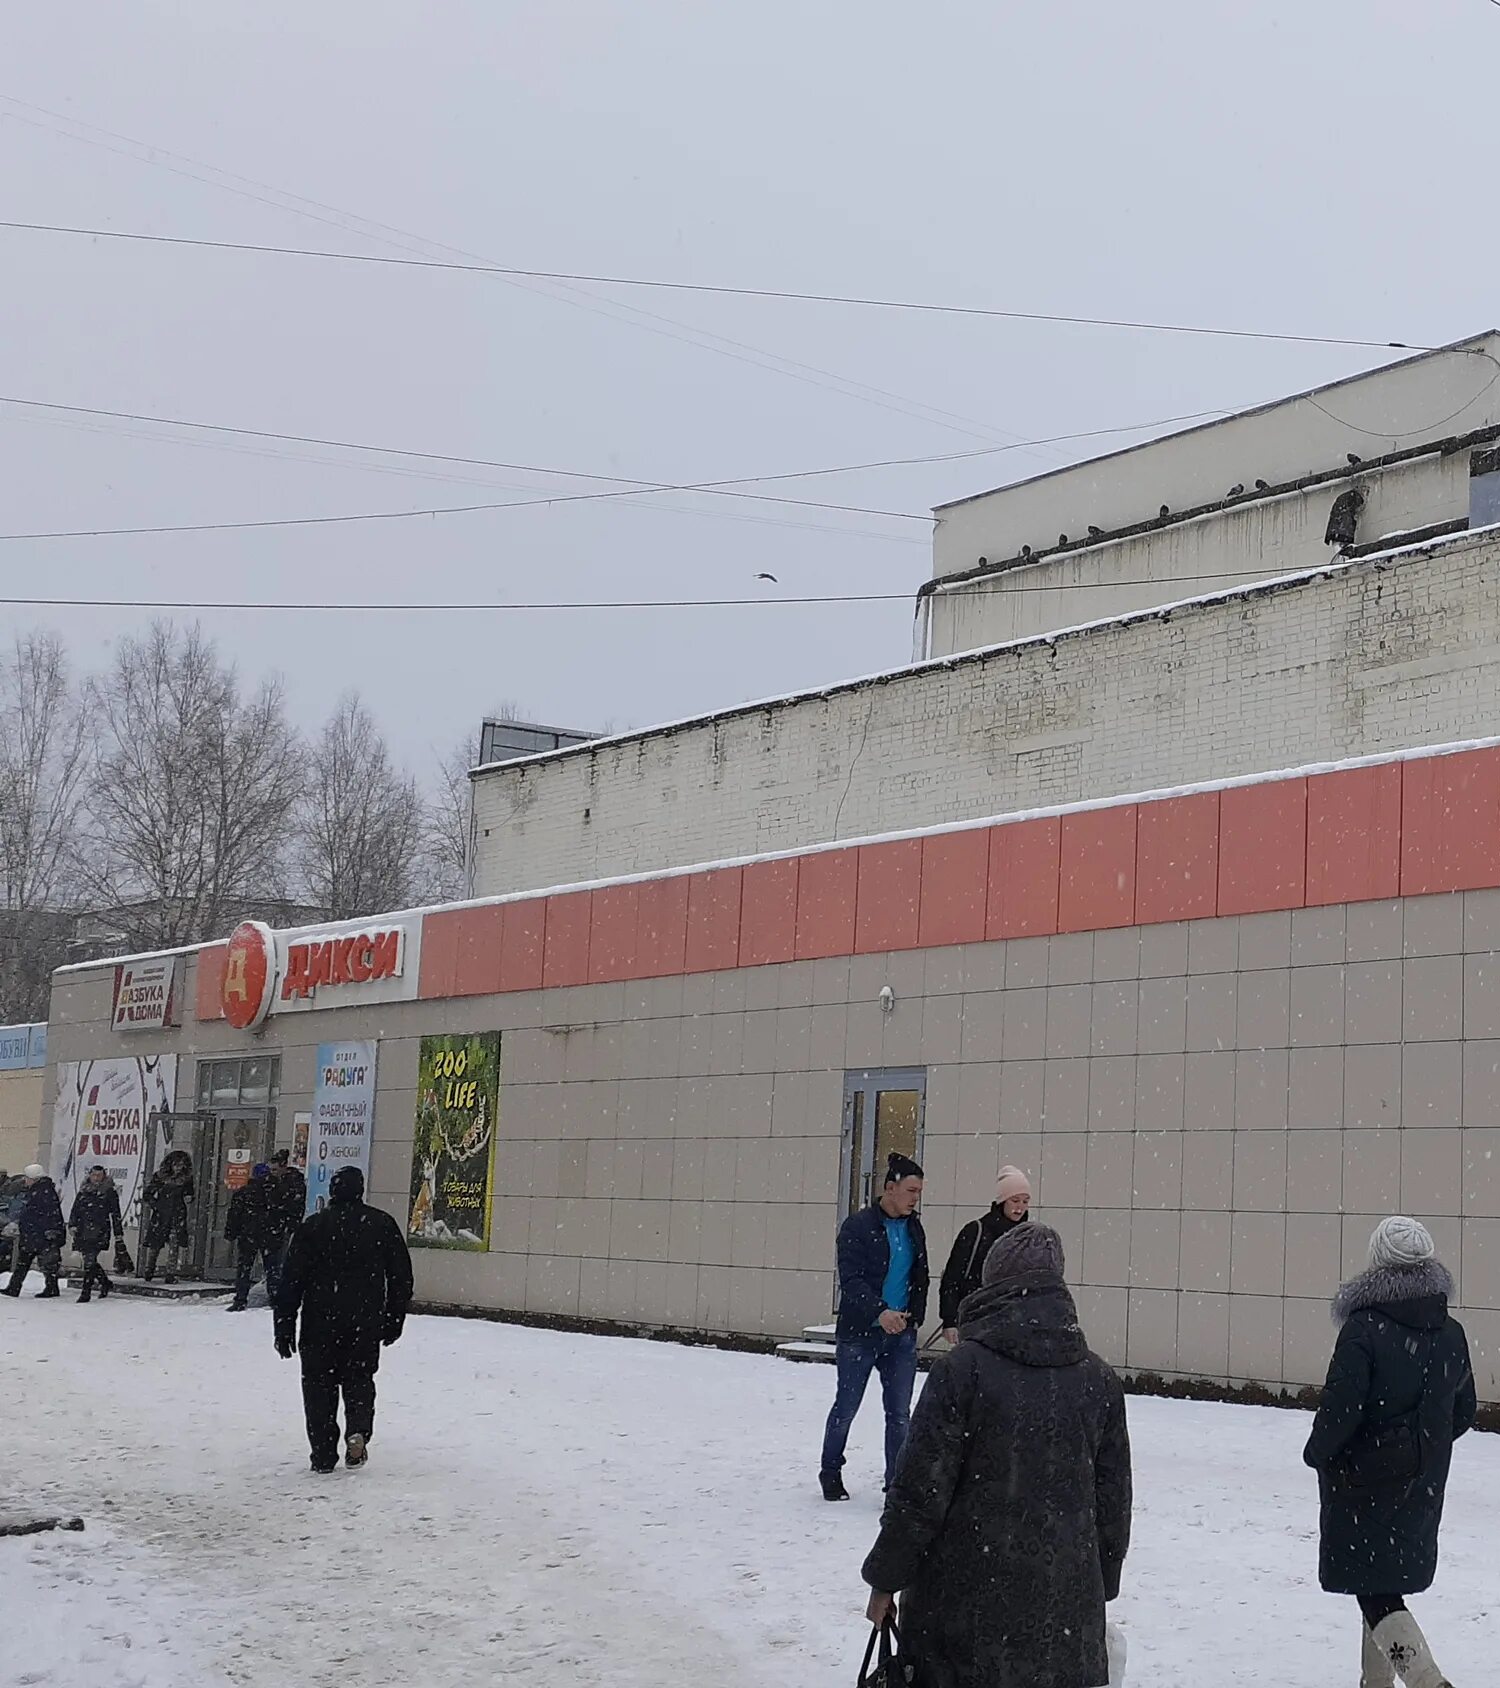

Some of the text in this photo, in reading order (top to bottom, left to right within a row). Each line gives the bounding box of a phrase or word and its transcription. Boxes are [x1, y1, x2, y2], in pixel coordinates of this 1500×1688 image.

[224, 948, 247, 1003] Д
[280, 930, 402, 1001] ДИКСИ
[128, 985, 164, 1004] АЗБУКА
[134, 1003, 163, 1021] ДОМА
[336, 1051, 358, 1062] ОТДЕЛ
[433, 1049, 469, 1080] ZOO
[445, 1081, 478, 1110] LIFE
[92, 1108, 140, 1130] АЗБУКА
[319, 1100, 367, 1118] ФАБРИЧНЫЙ
[318, 1121, 366, 1137] ТРИКОТАЖ
[102, 1133, 139, 1156] ДОМА
[329, 1144, 362, 1159] ЖЕНСКИЙ
